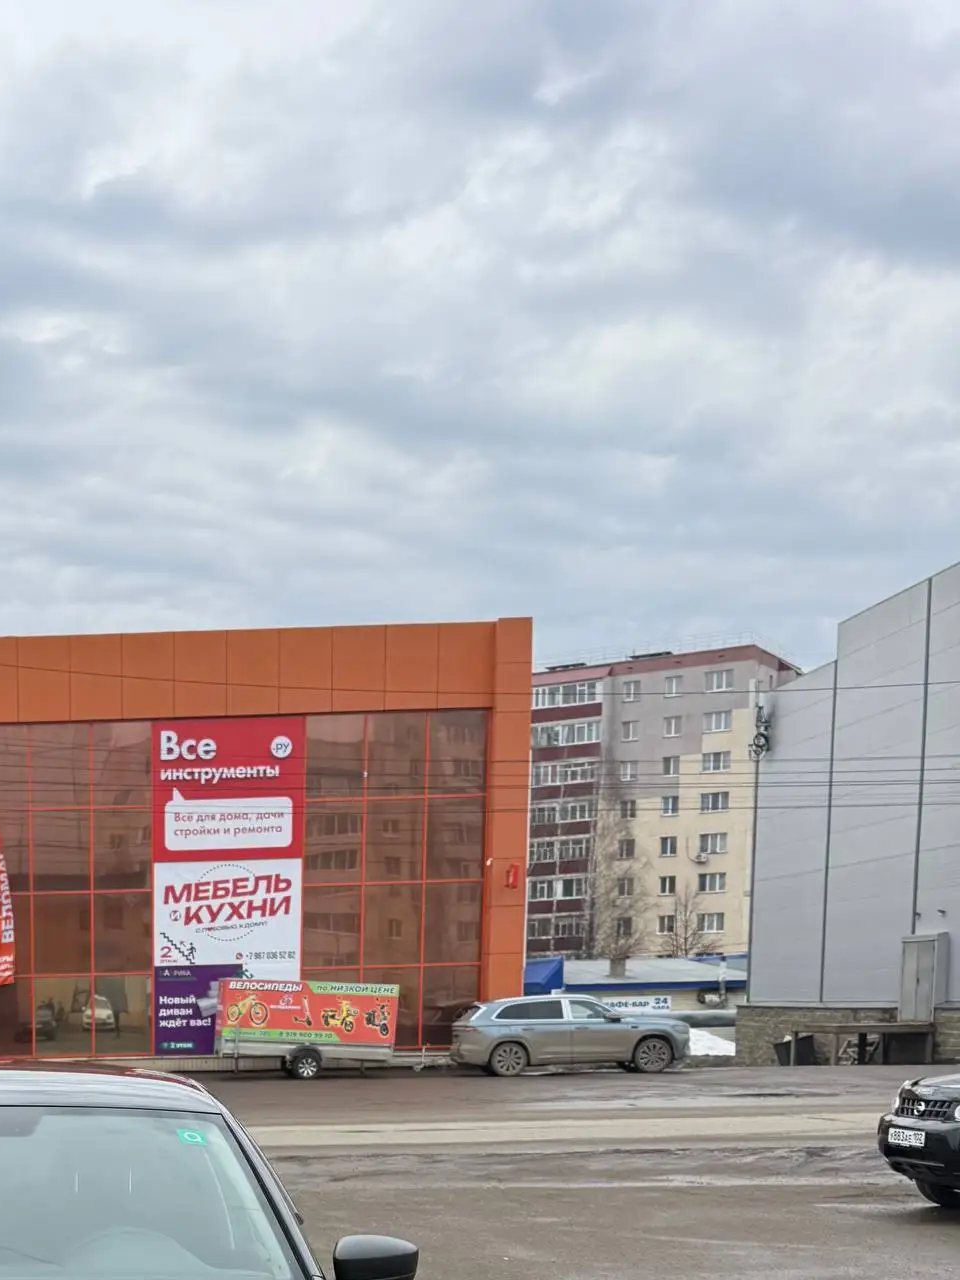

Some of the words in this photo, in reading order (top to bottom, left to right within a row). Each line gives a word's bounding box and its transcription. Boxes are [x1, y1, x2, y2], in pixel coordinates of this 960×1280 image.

[159, 730, 217, 760] Все
[159, 764, 280, 785] инструменты
[196, 813, 216, 823] для
[218, 812, 252, 822] дома,
[255, 811, 285, 822] дачи
[173, 826, 220, 839] стройки
[223, 827, 230, 835] и
[233, 825, 283, 837] ремонта
[162, 873, 293, 905] МЕБЕЛЬ
[183, 895, 293, 926] КУХНИ
[160, 946, 172, 959] 2
[228, 980, 303, 992] ВЕЛОСИПЕДЫ
[159, 994, 196, 1005] Новый
[654, 997, 668, 1005] 24
[158, 1008, 193, 1017] диван
[159, 1017, 188, 1028] ждёт
[189, 1017, 212, 1027] вас!
